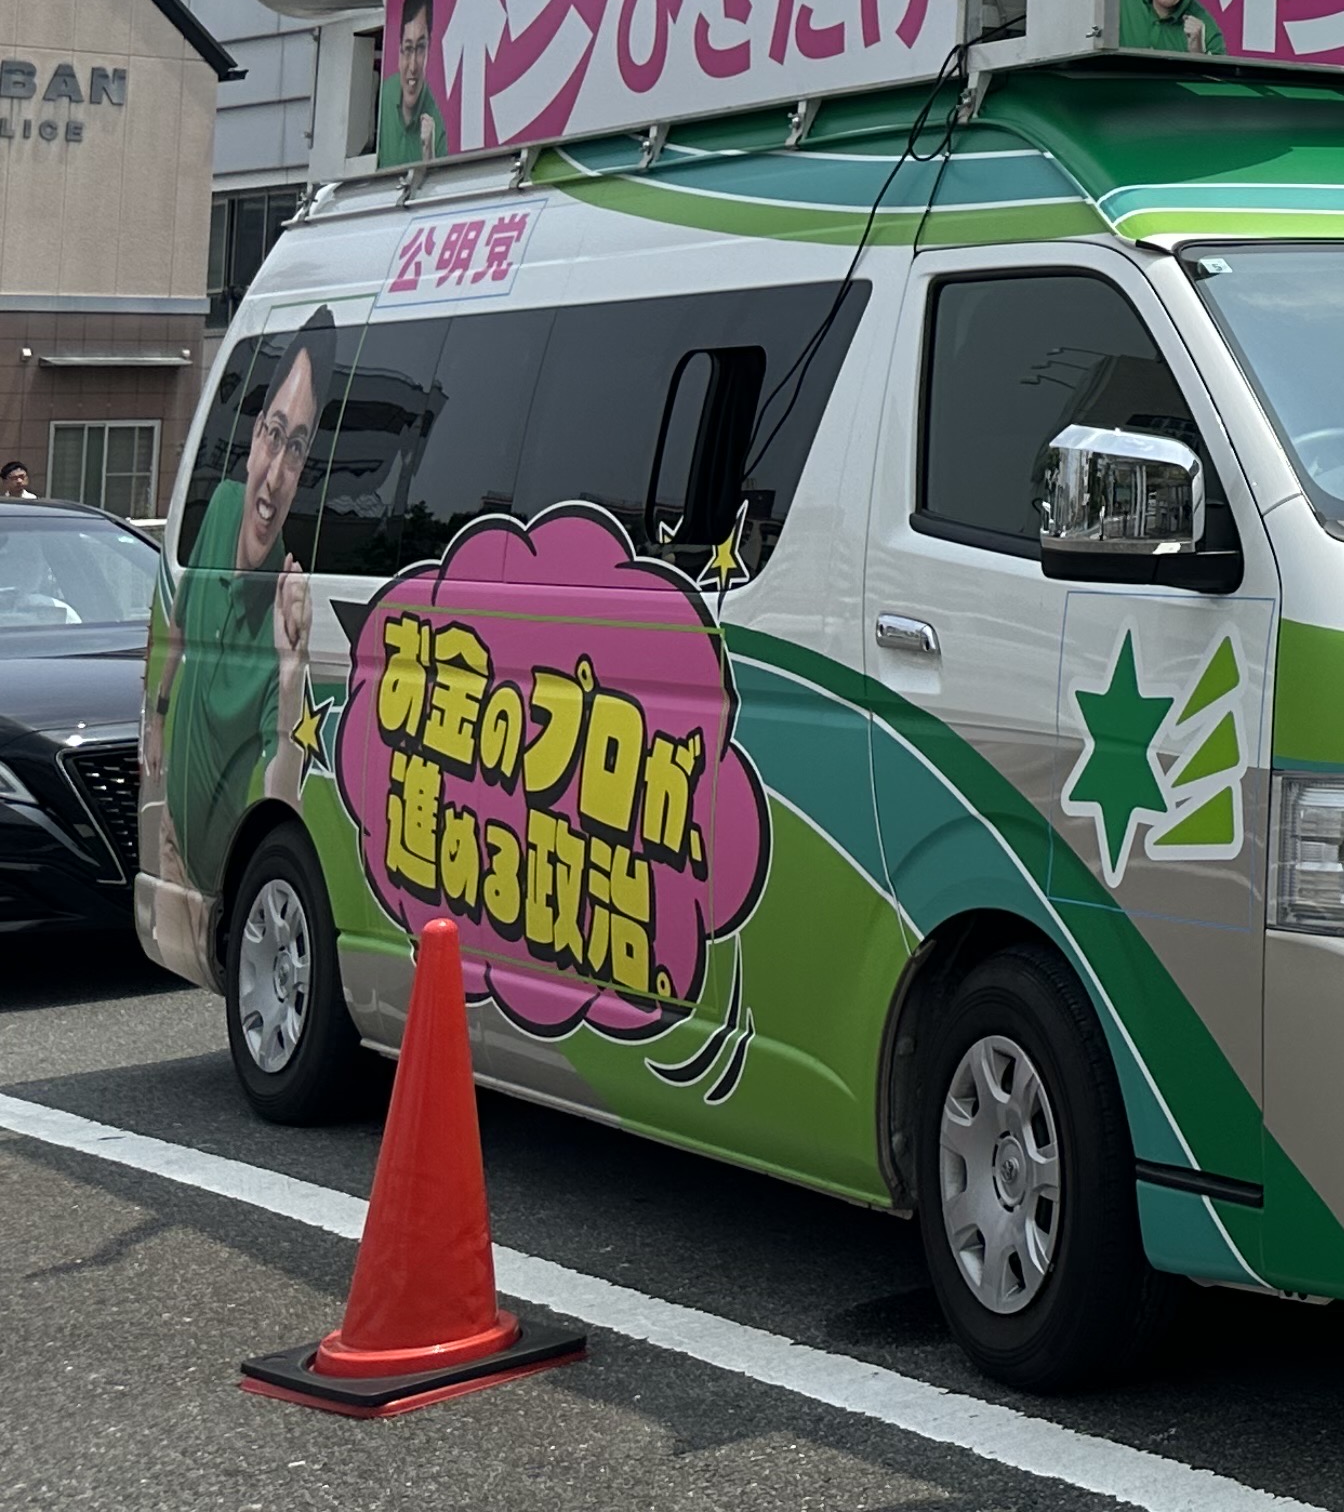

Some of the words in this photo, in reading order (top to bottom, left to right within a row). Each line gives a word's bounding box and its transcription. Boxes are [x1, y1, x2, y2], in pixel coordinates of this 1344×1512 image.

[389, 212, 530, 294] 公明党
[378, 616, 703, 864] お金のプロが、
[386, 752, 671, 998] 進める政治。
